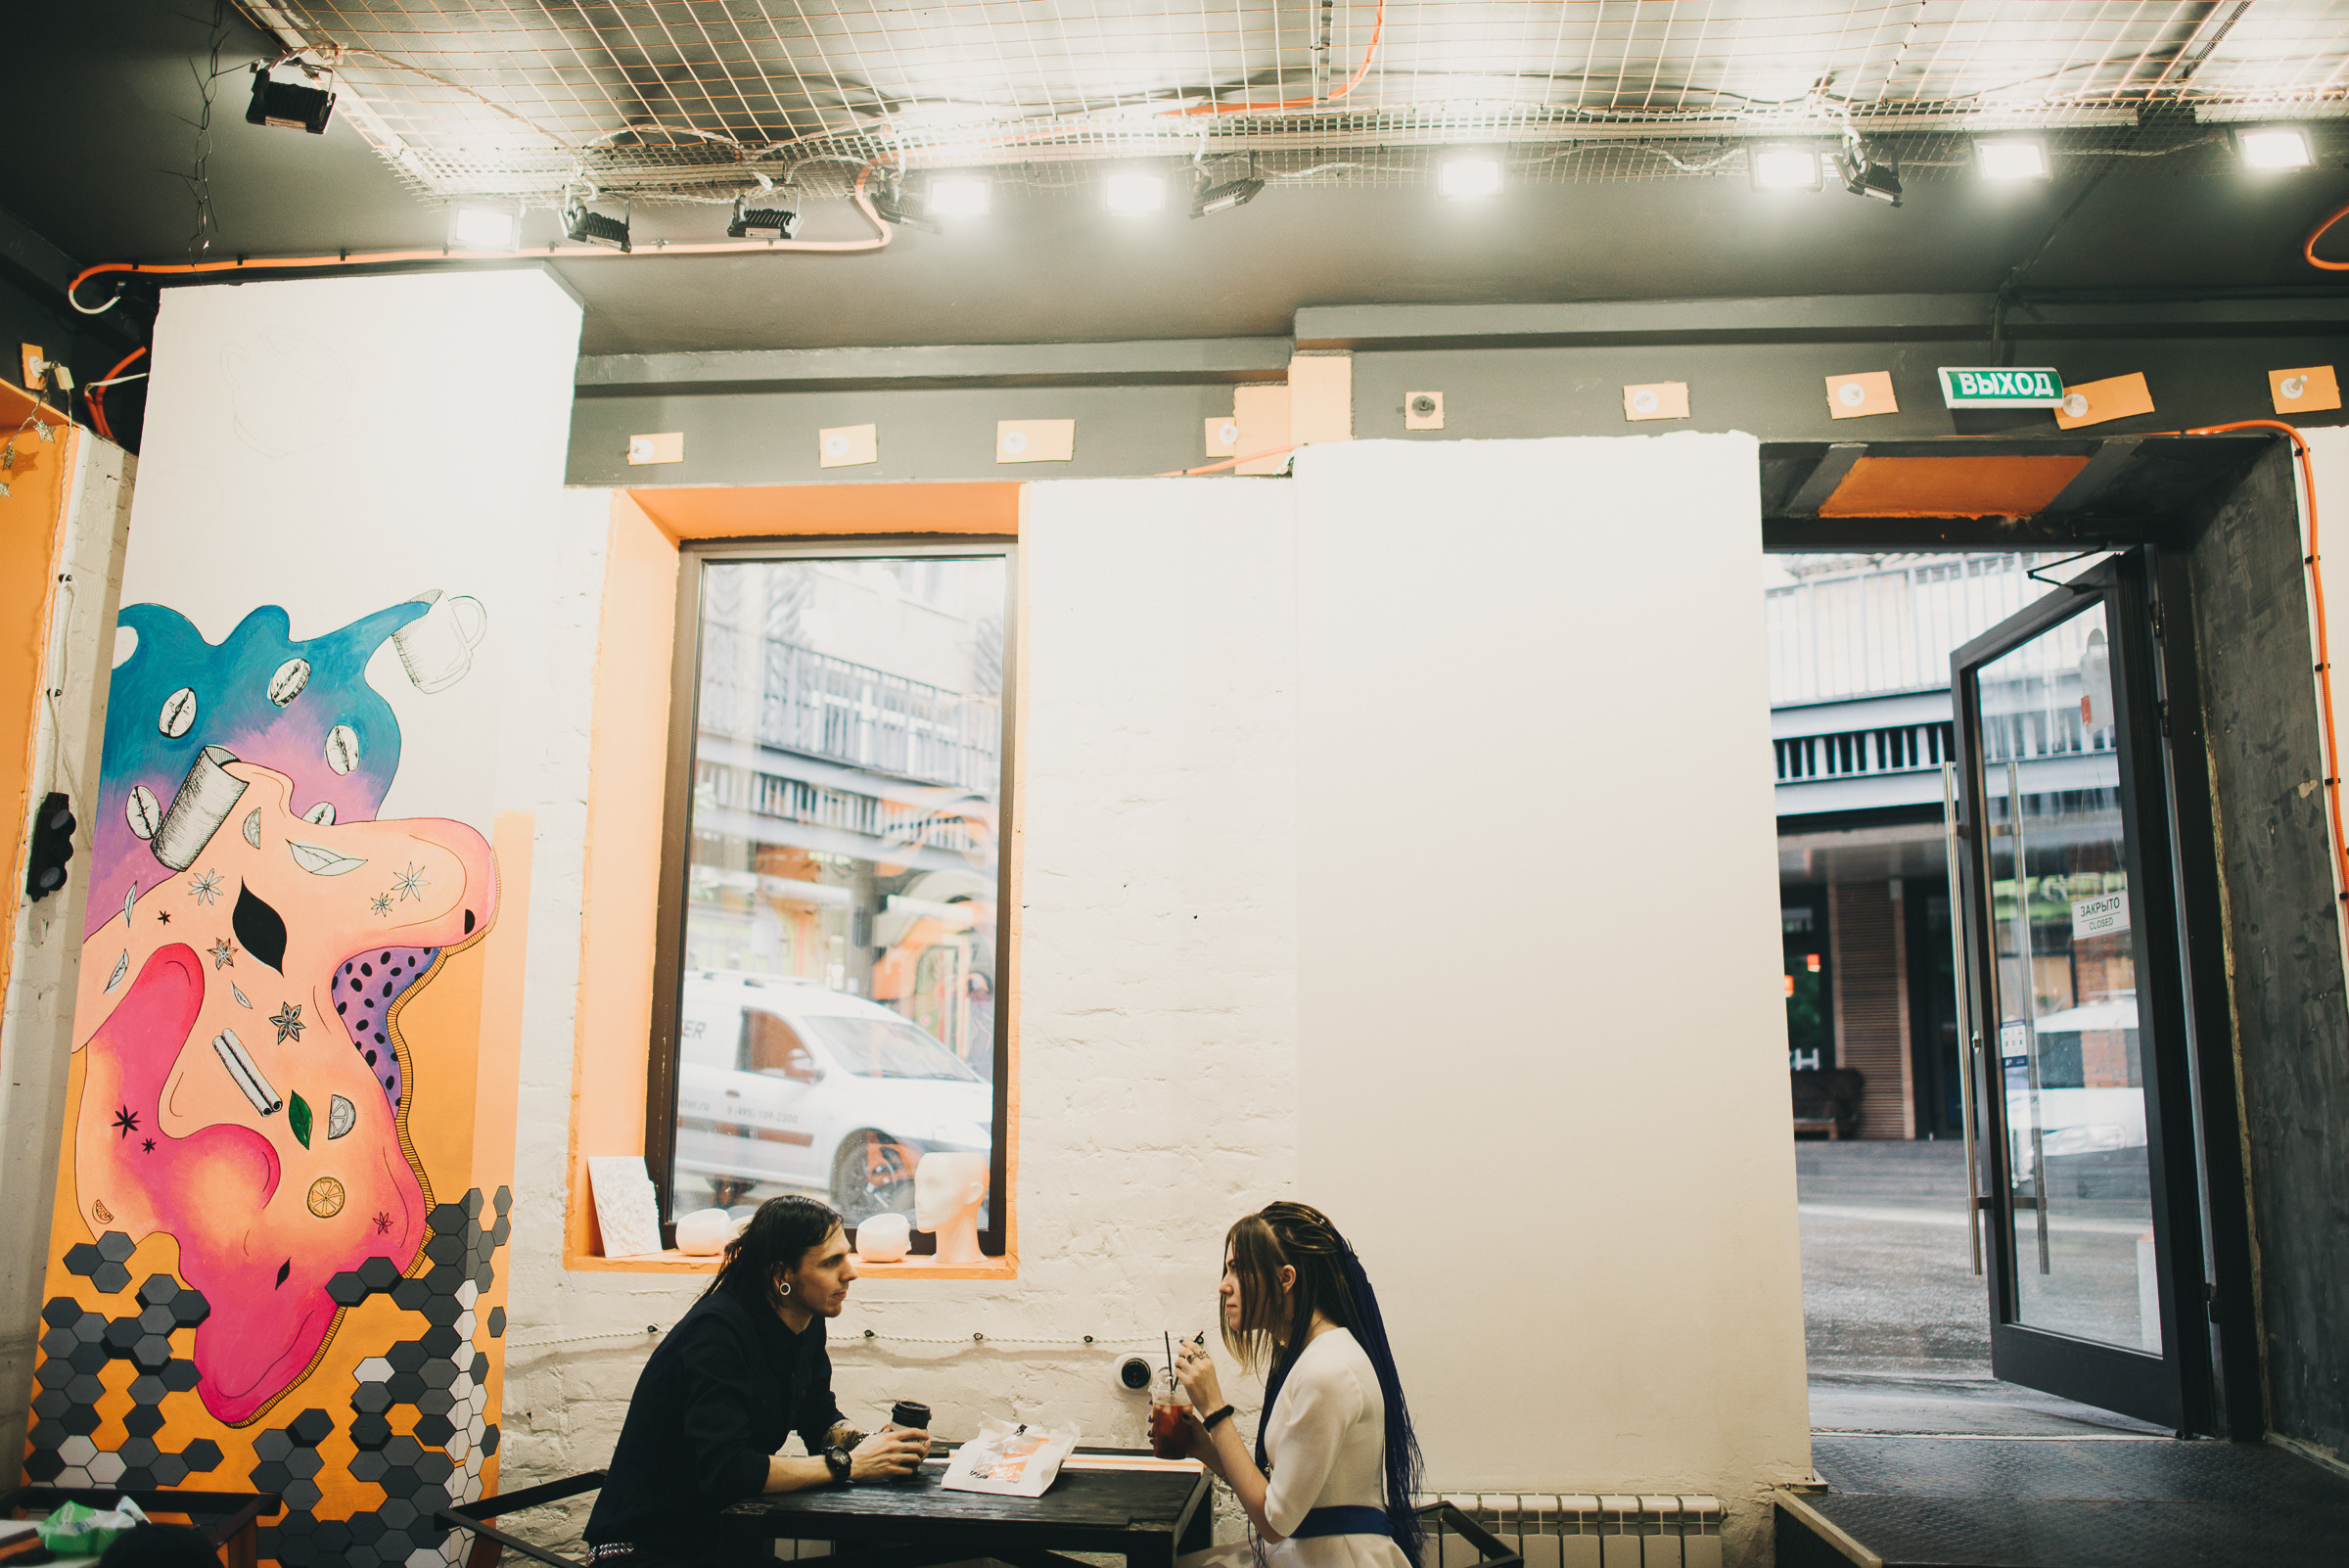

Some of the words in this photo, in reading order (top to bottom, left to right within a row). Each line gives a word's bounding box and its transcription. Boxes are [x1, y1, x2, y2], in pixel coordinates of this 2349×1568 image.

[1958, 372, 2054, 397] ВЫХОД
[2080, 897, 2121, 917] ЗАКРЫТО
[2089, 917, 2114, 931] CLOSED
